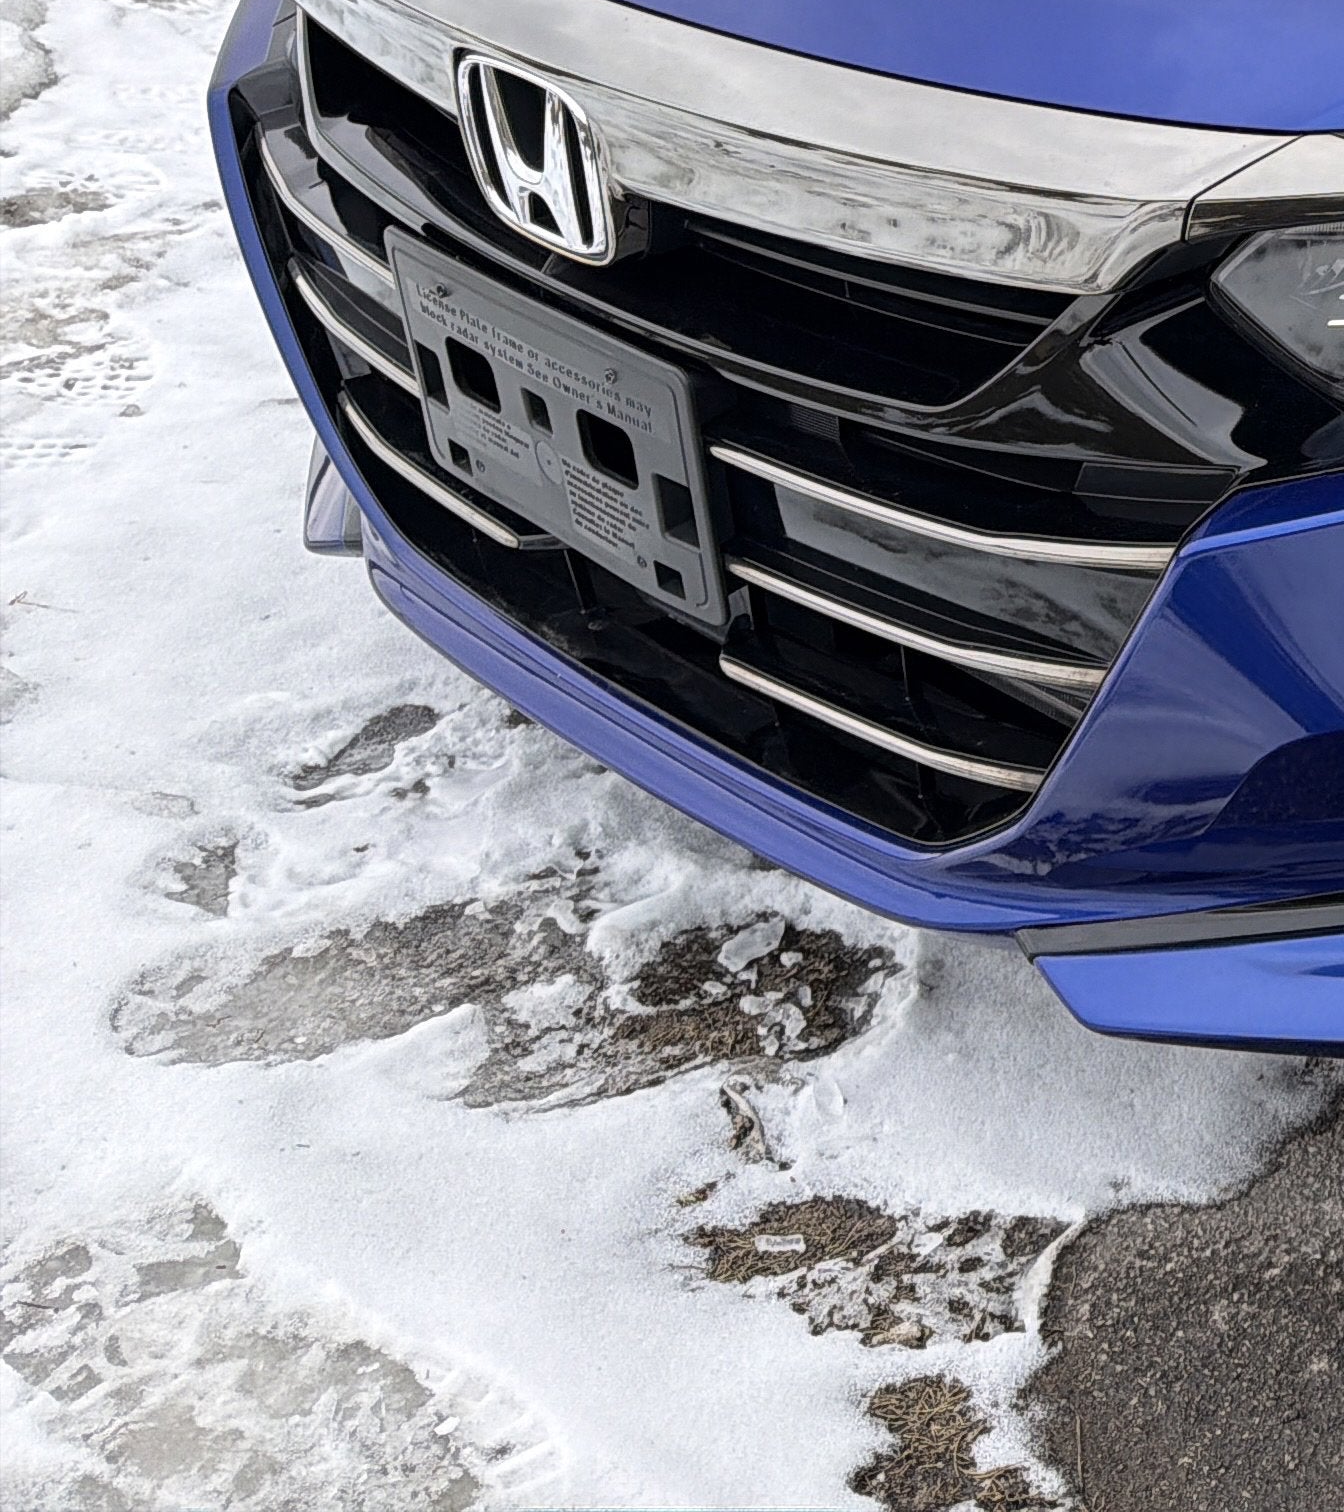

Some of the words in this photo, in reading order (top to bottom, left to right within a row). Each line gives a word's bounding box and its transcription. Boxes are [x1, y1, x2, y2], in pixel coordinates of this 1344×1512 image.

[416, 282, 457, 317] License
[459, 309, 488, 334] Plate
[491, 326, 524, 353] frame
[527, 349, 539, 361] or
[544, 357, 621, 402] accessories
[625, 396, 652, 418] may
[420, 300, 448, 327] block
[450, 321, 479, 345] radar
[483, 340, 524, 370] system
[526, 362, 549, 383] See
[606, 401, 653, 434] Manual
